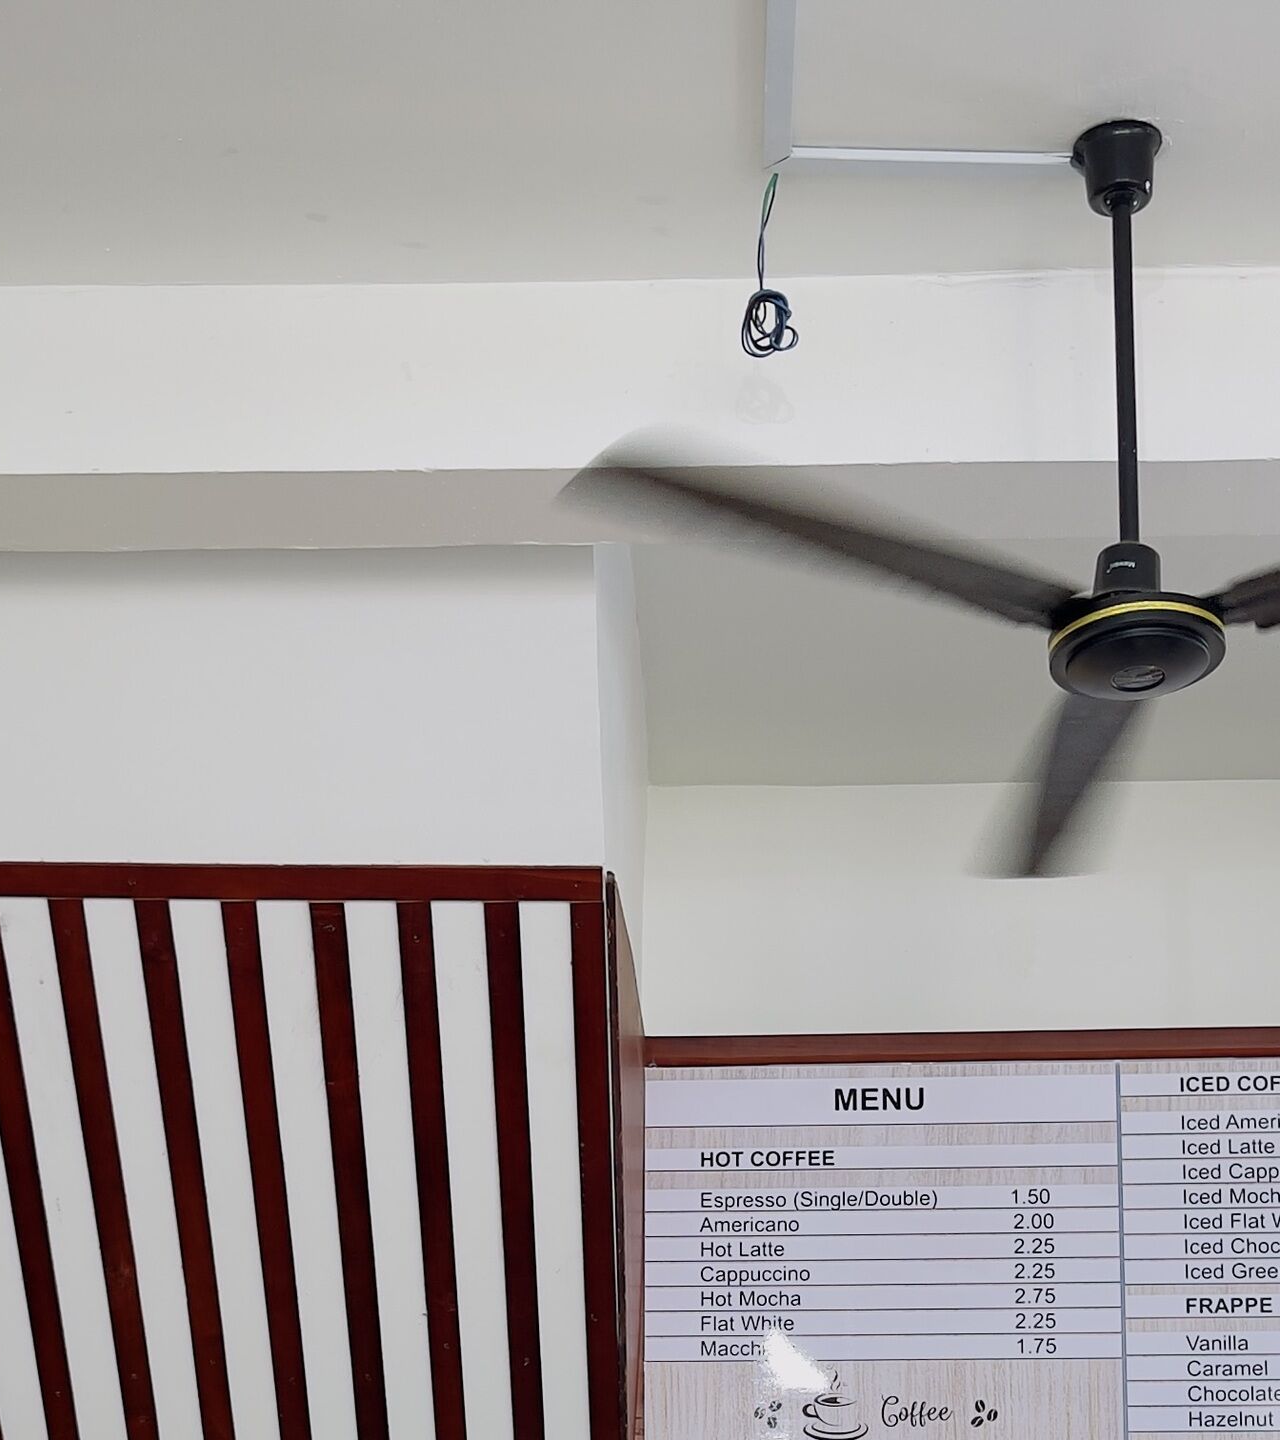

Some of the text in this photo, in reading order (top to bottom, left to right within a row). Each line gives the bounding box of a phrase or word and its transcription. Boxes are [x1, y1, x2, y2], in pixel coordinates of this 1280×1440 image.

[1180, 1076, 1230, 1093] ICED
[834, 1087, 925, 1112] MENU
[1181, 1114, 1220, 1131] Iced
[1182, 1138, 1221, 1156] Iced
[1228, 1138, 1275, 1155] Latte
[700, 1150, 835, 1168] HOT COFFEE
[1182, 1163, 1222, 1180] Iced
[700, 1188, 1051, 1211] Espresso (Single/Double) 1.50
[1183, 1188, 1222, 1205] Iced
[699, 1213, 1054, 1233] Americano 2.00
[1183, 1213, 1223, 1230] Iced
[1230, 1212, 1266, 1229] Flat
[700, 1237, 1055, 1258] Hot Latte 2.25
[1184, 1238, 1224, 1255] Iced
[700, 1262, 1056, 1286] Cappuccino 2.25
[1185, 1263, 1224, 1280] Iced
[700, 1287, 1056, 1307] Hot Mocha 2.75
[1186, 1297, 1273, 1314] FRAPPE
[701, 1312, 1056, 1332] Flat White 2.25
[1017, 1337, 1057, 1354] 1.75
[1185, 1335, 1249, 1352] Vanilla
[1187, 1359, 1268, 1377] Caramel
[881, 1394, 953, 1428] Coffee
[1188, 1410, 1274, 1428] Hazelnut
